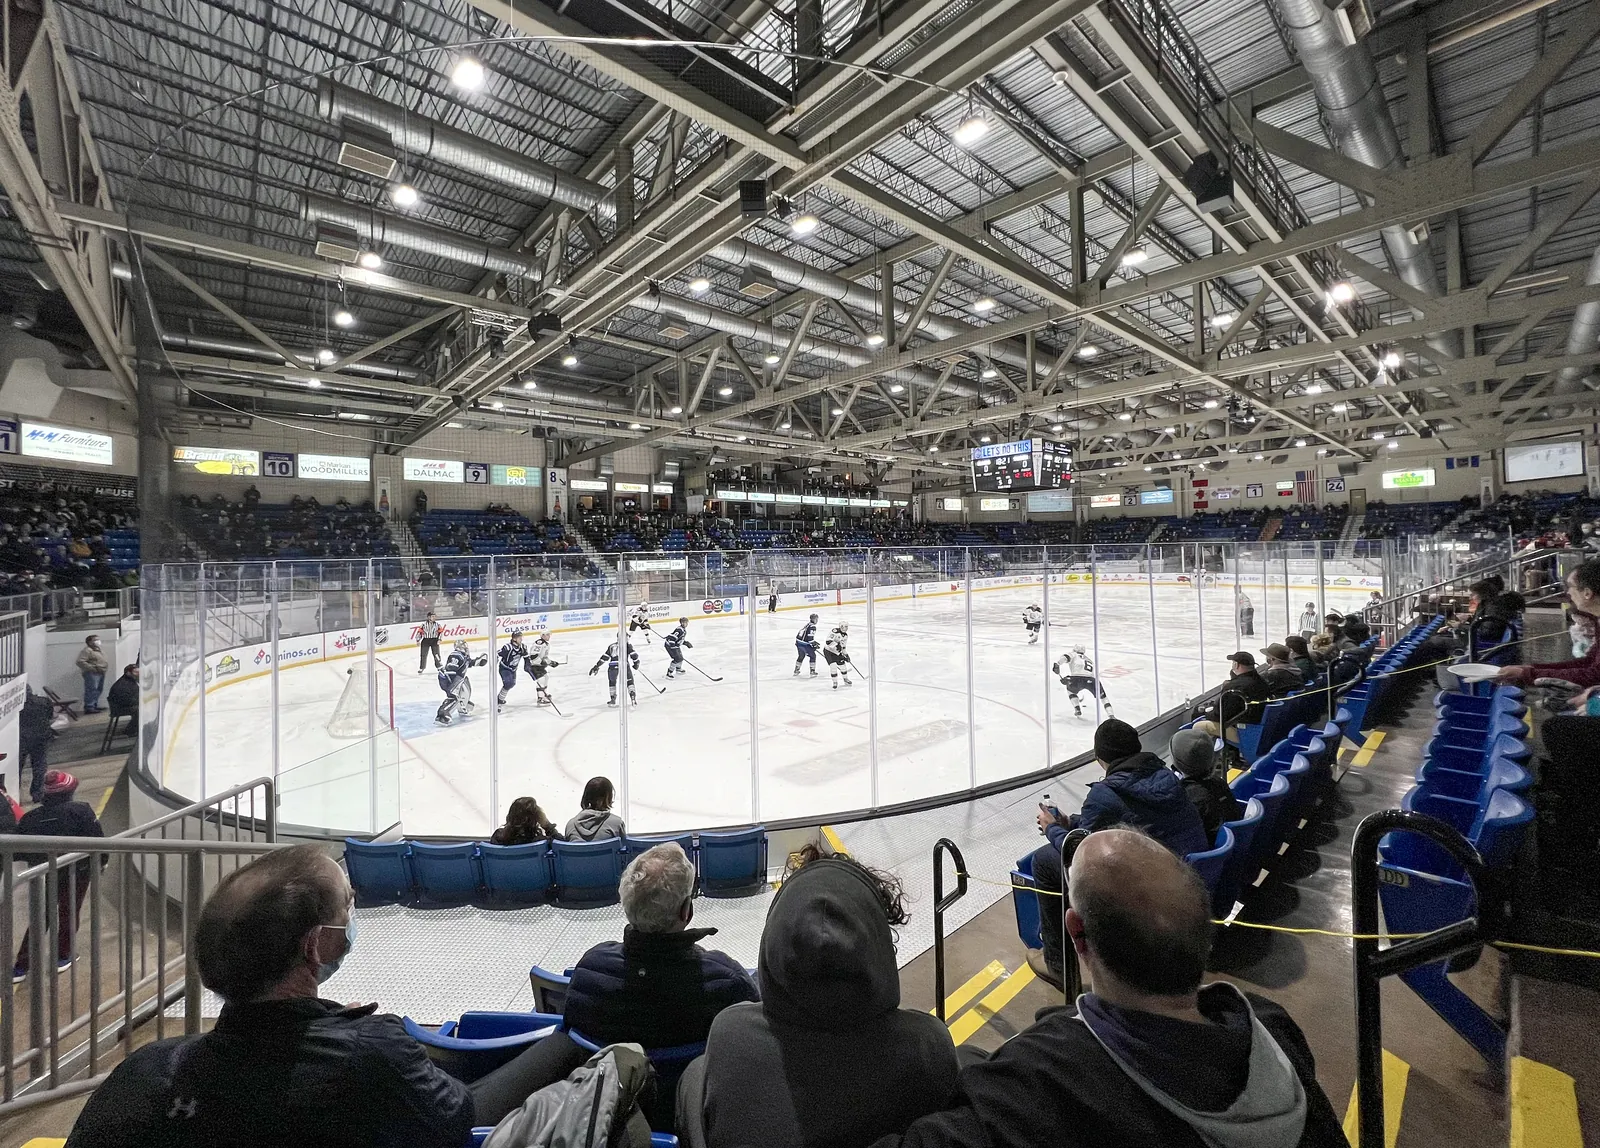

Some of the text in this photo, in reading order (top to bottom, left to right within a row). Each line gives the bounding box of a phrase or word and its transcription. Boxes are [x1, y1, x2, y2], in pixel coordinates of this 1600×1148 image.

[59, 433, 108, 448] Furniture
[983, 446, 1000, 457] LET'S
[1002, 445, 1011, 454] DO
[267, 461, 290, 475] 10
[301, 466, 369, 476] WOODMILLERS
[413, 468, 455, 478] DALMAC
[472, 470, 481, 482] 9
[507, 477, 526, 486] PRO
[550, 471, 556, 482] 8
[265, 647, 318, 665] Dminos.ca
[1084, 659, 1093, 672] 6
[1384, 870, 1404, 885] DD
